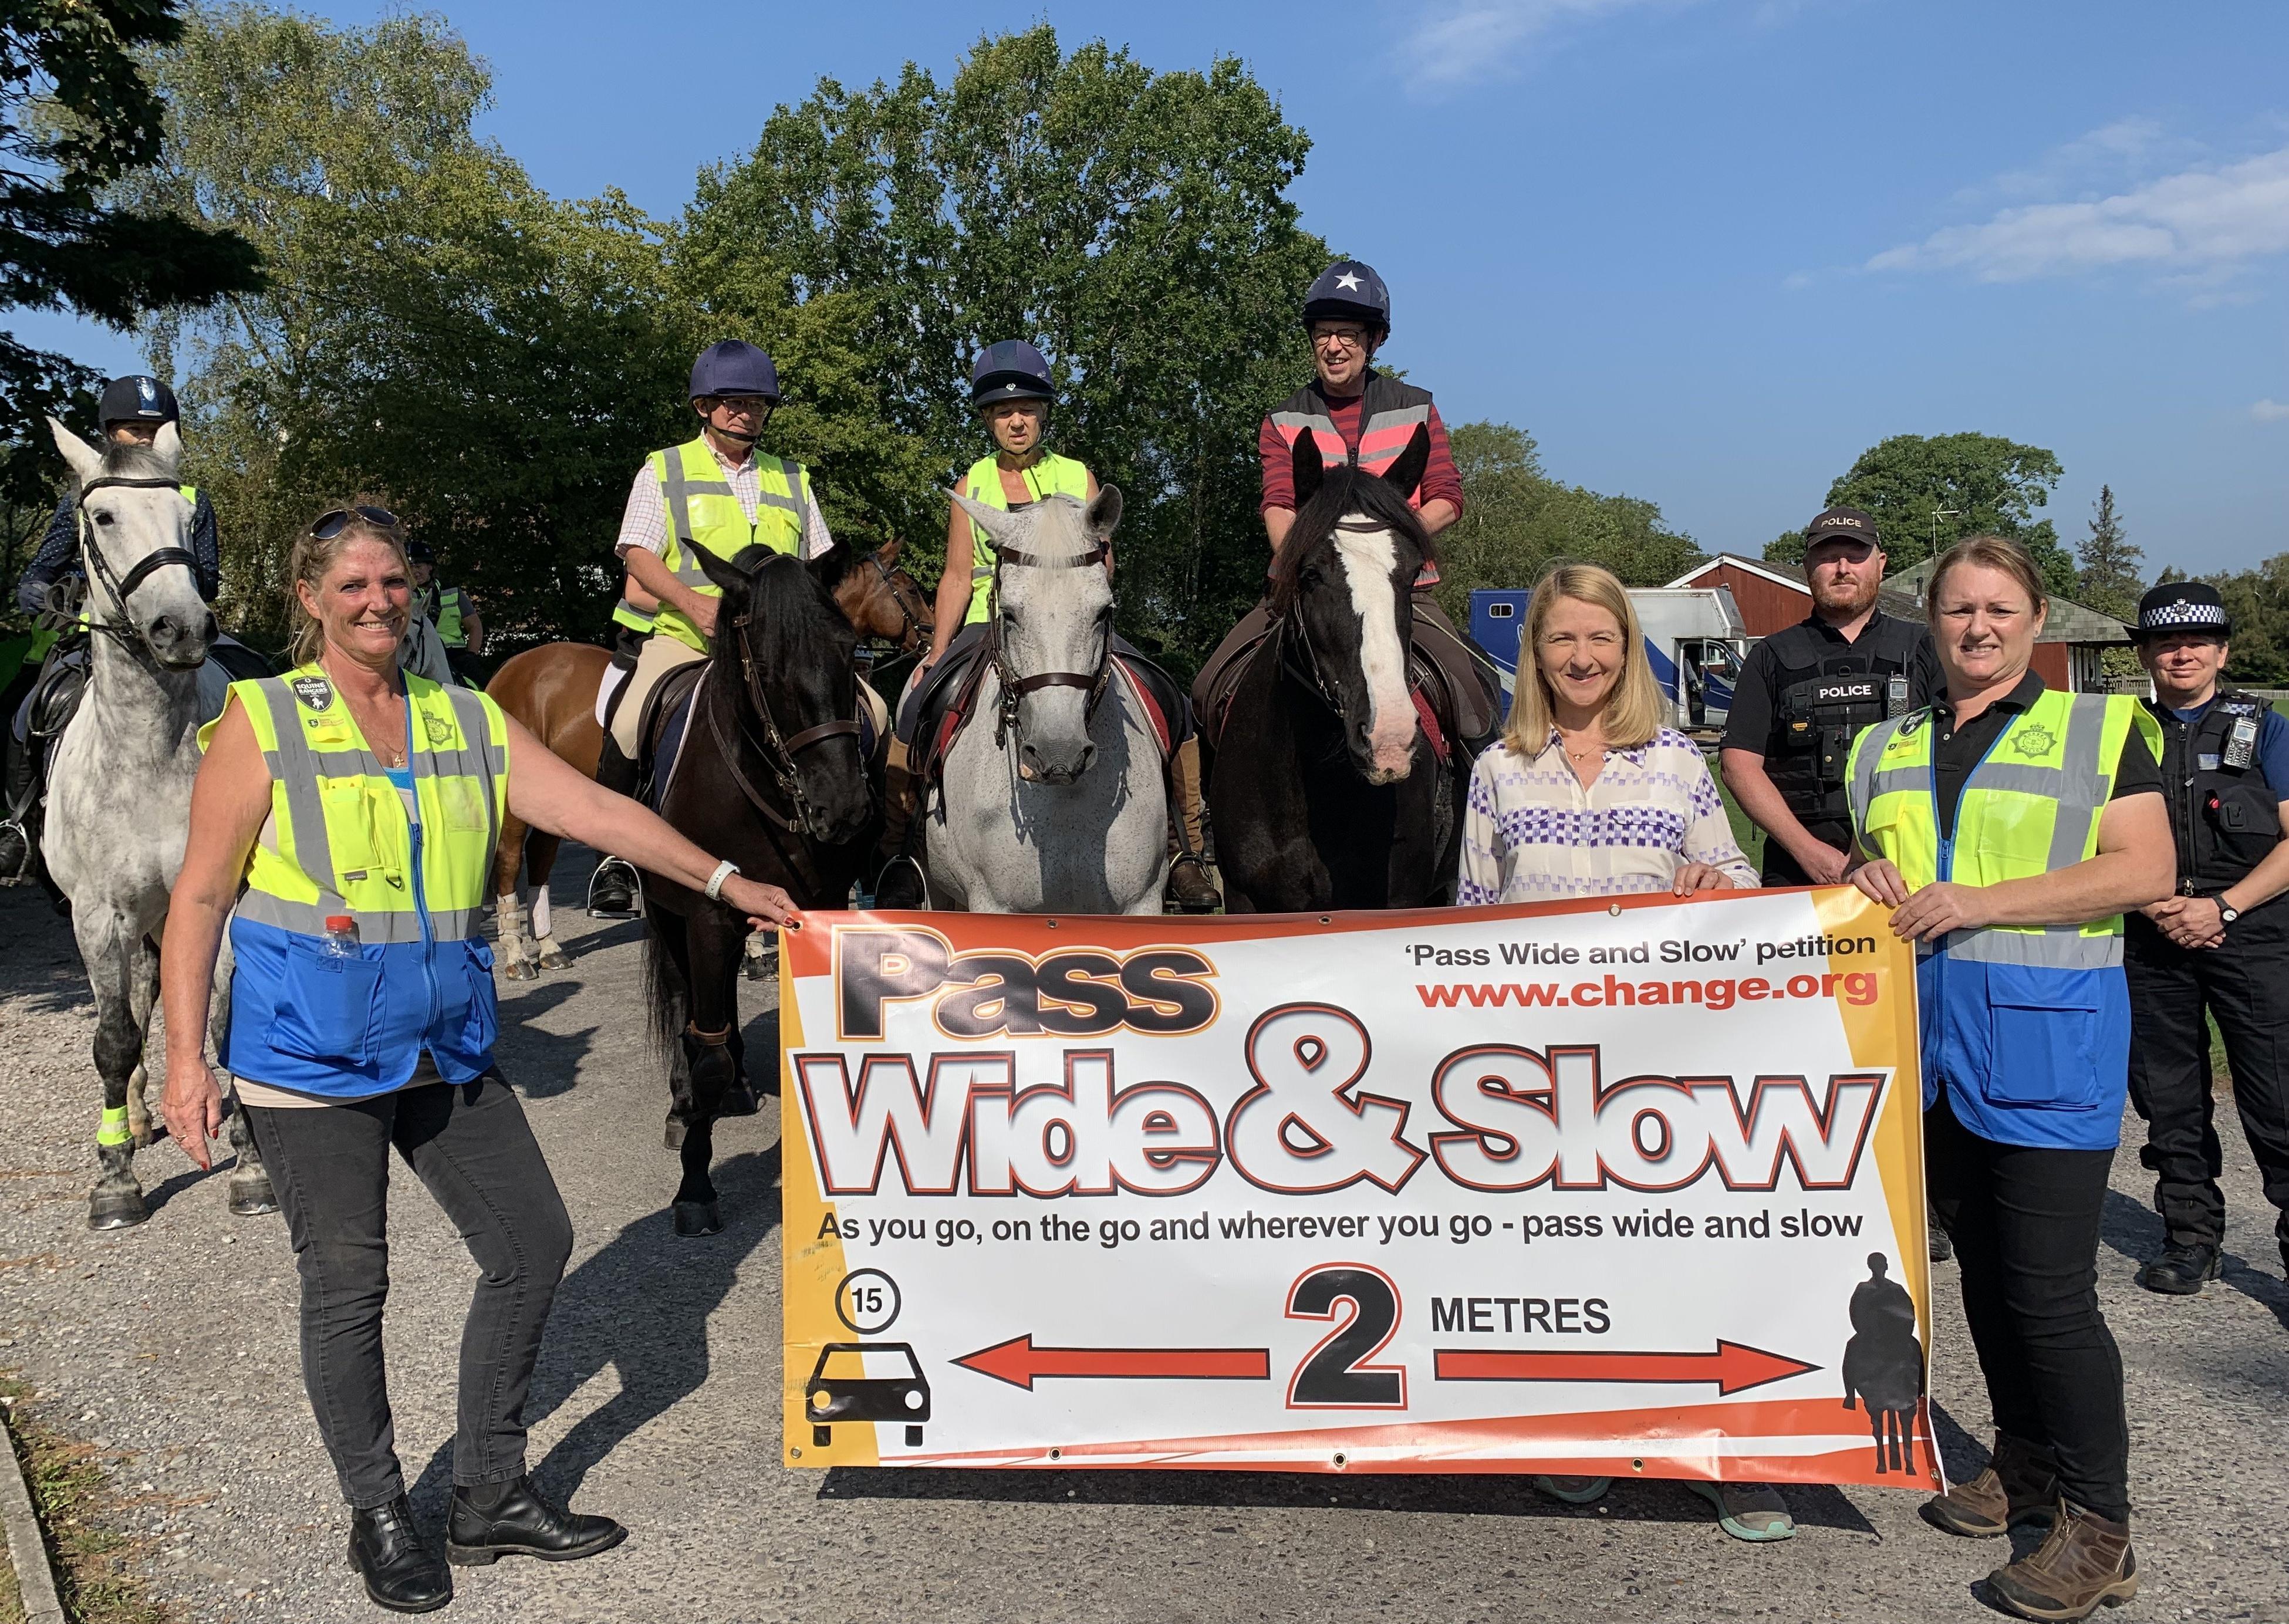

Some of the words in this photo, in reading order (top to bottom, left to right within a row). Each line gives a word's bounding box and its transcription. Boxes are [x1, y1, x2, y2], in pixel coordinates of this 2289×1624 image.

[1821, 517, 1862, 528] POLICE
[1819, 685, 1872, 698] POLICE
[1498, 943, 1579, 964] Wide
[1589, 941, 1649, 964] and
[1756, 934, 1876, 965] petition
[832, 924, 1221, 1042] Pass
[1414, 973, 1879, 1010] www.change.org
[793, 1048, 1225, 1197] Wide
[1224, 1001, 1430, 1196] &
[1428, 1043, 1887, 1194] Slow
[817, 1212, 860, 1240] As
[868, 1218, 926, 1247] you
[936, 1219, 983, 1247] go,
[992, 1220, 1031, 1241] on
[1040, 1214, 1091, 1241] the
[1099, 1220, 1140, 1249] go
[1150, 1211, 1209, 1241] and
[1218, 1210, 1370, 1239] wherever
[1377, 1216, 1439, 1245] you
[1449, 1215, 1492, 1244] go
[1522, 1215, 1603, 1244] pass
[1612, 1208, 1694, 1238] wide
[1704, 1209, 1770, 1239] and
[1780, 1208, 1863, 1238] slow
[852, 1288, 883, 1313] 15
[1284, 1261, 1409, 1411] 2
[1431, 1297, 1611, 1334] METRES
